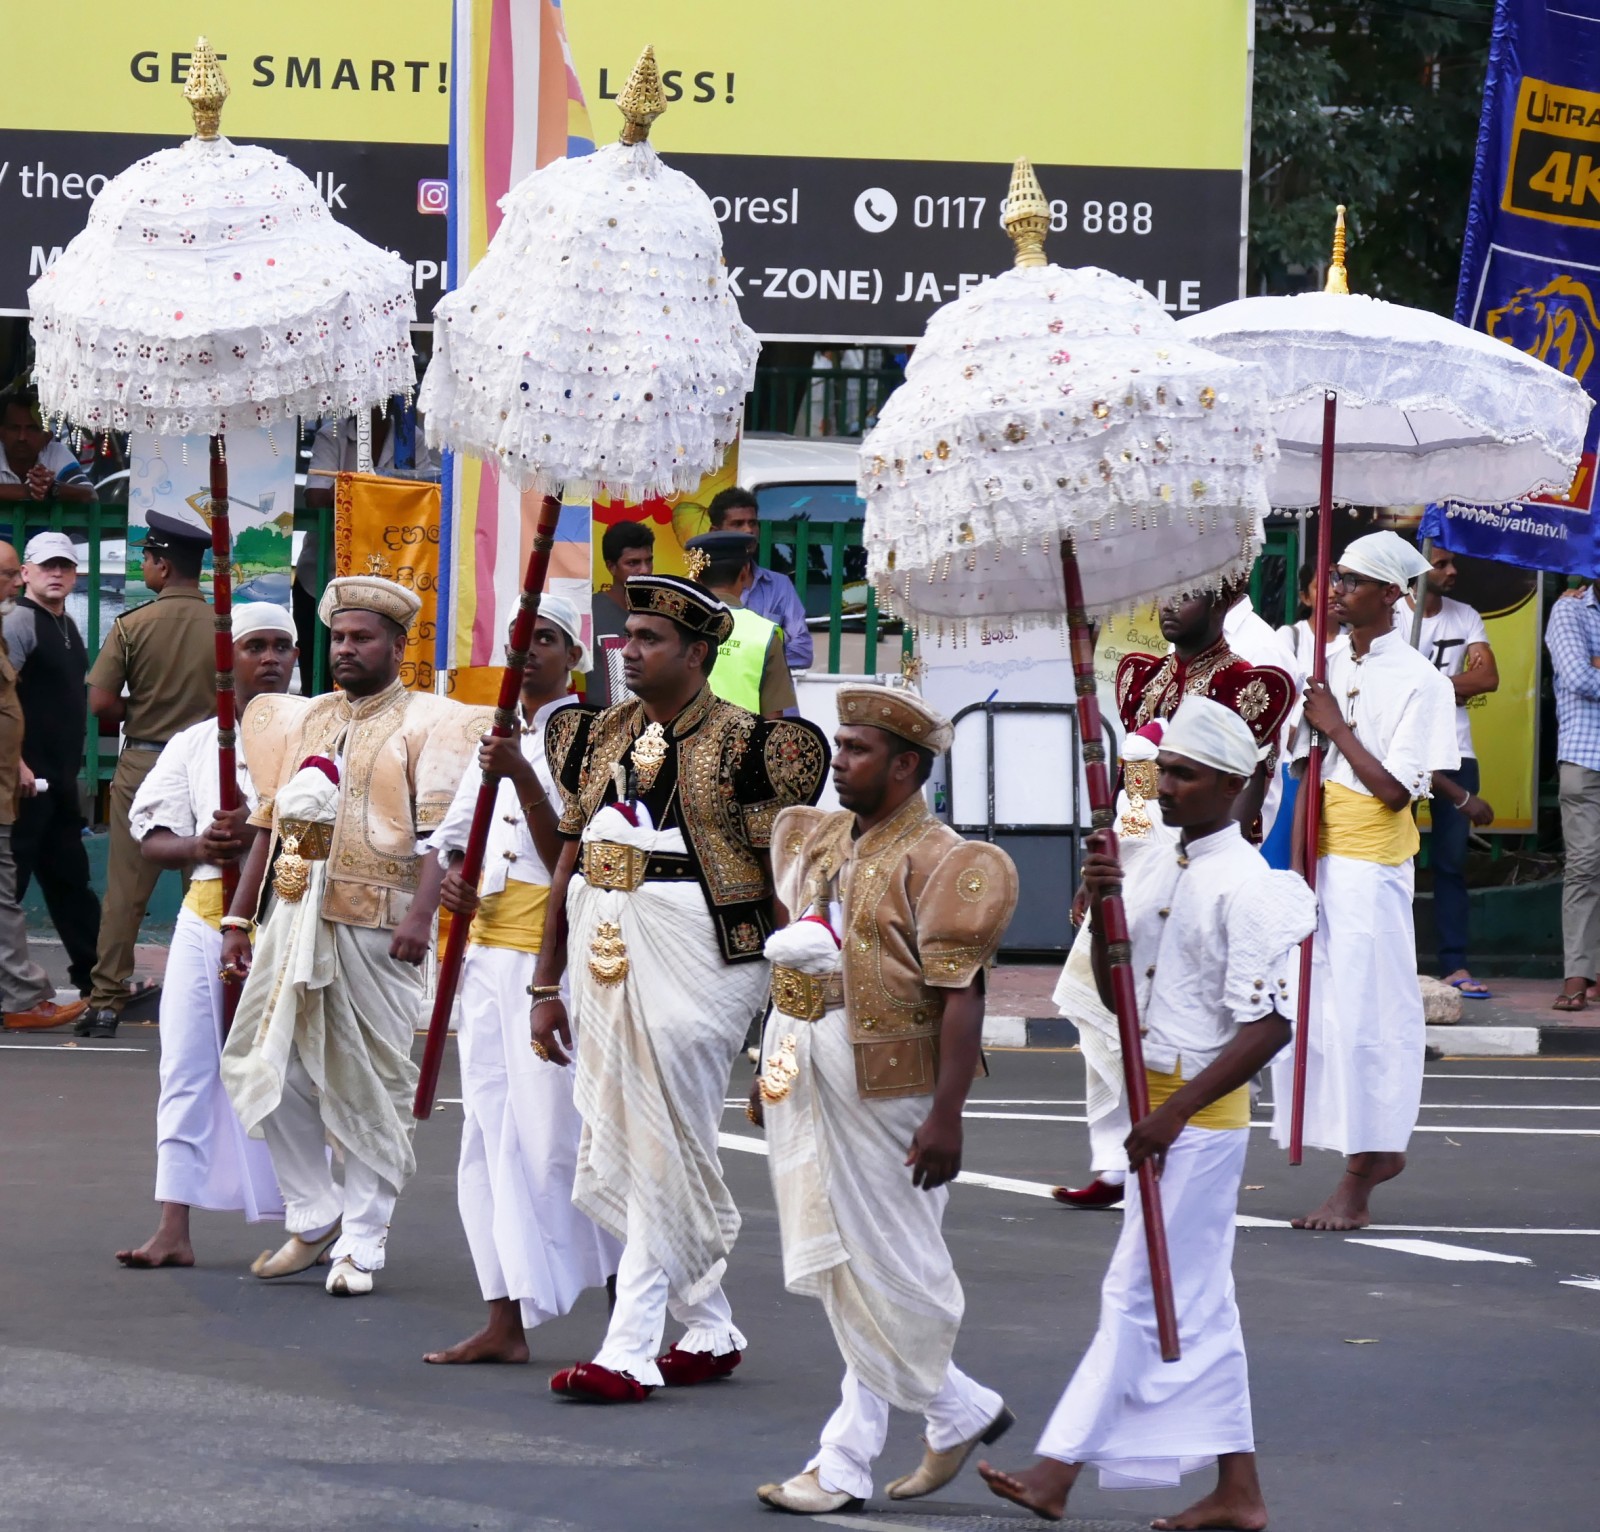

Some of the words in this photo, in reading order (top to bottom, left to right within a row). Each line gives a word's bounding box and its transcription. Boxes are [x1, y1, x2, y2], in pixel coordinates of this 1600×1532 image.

[130, 51, 227, 84] GE
[252, 55, 448, 94] SMART!
[599, 68, 734, 104] LSS!
[1528, 150, 1600, 206] 4K
[709, 188, 798, 224] oresl
[914, 195, 986, 229] 0117
[1083, 200, 1153, 235] 888
